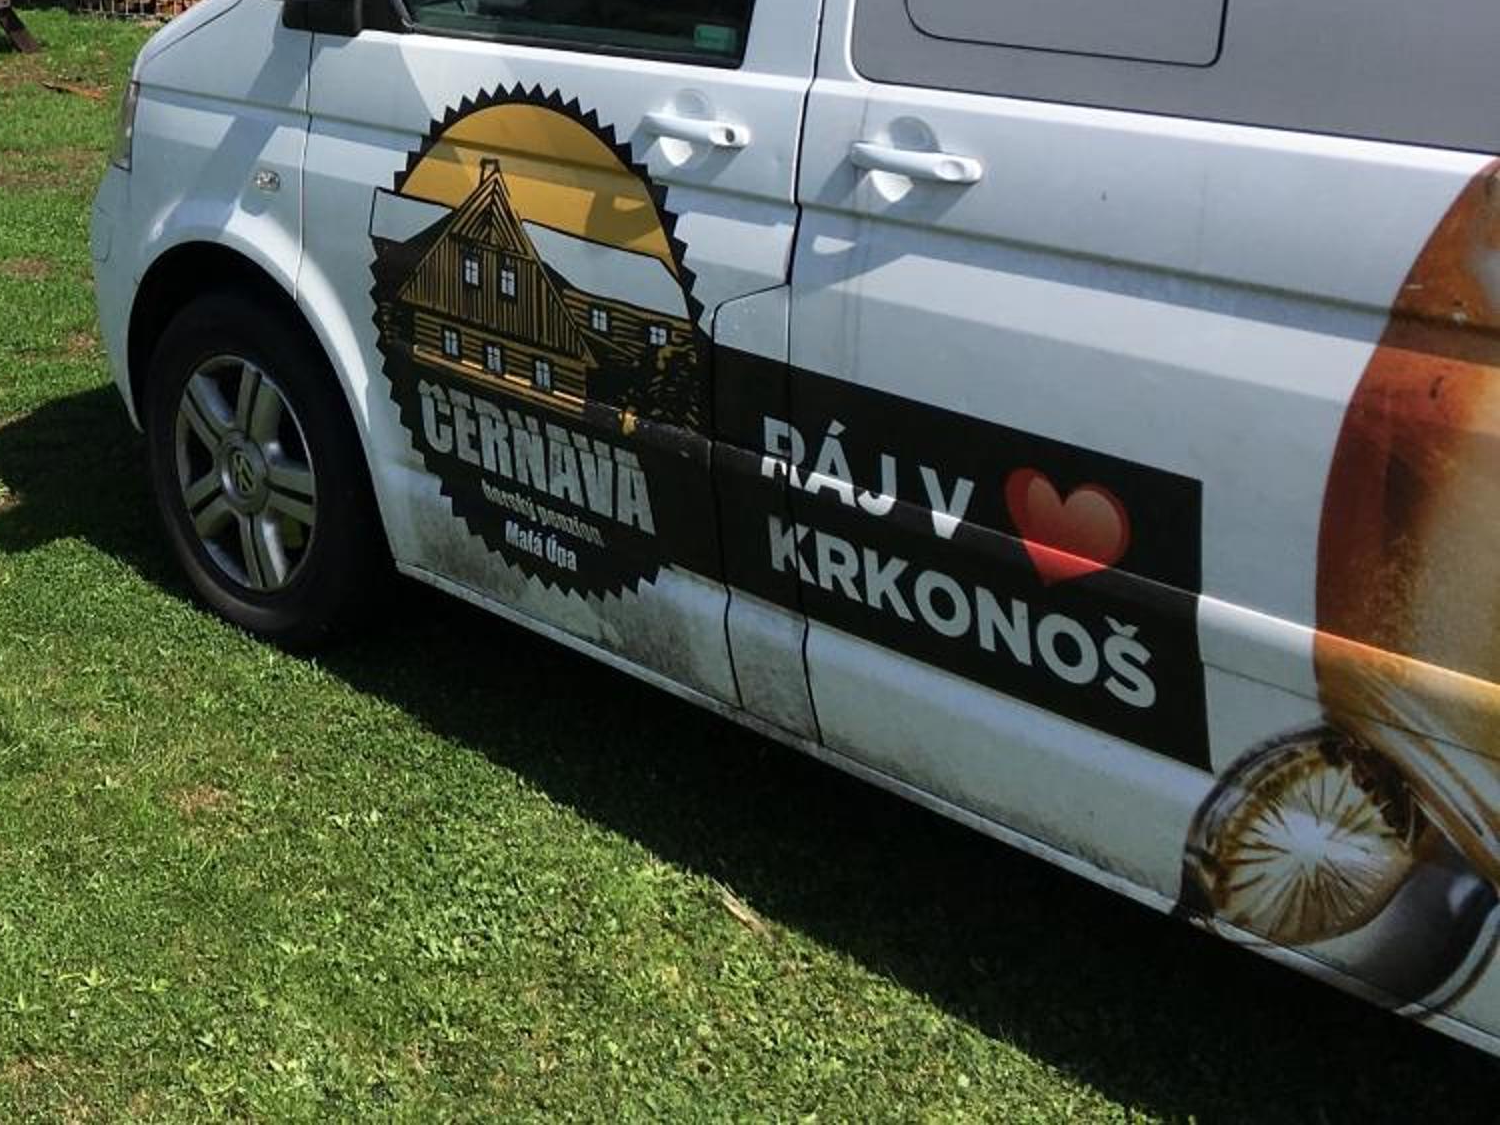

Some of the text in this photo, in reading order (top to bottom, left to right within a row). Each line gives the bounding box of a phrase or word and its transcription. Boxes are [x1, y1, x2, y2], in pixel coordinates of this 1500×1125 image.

[760, 415, 975, 540] RÁJ V
[767, 514, 1157, 709] KRKONOŠ
